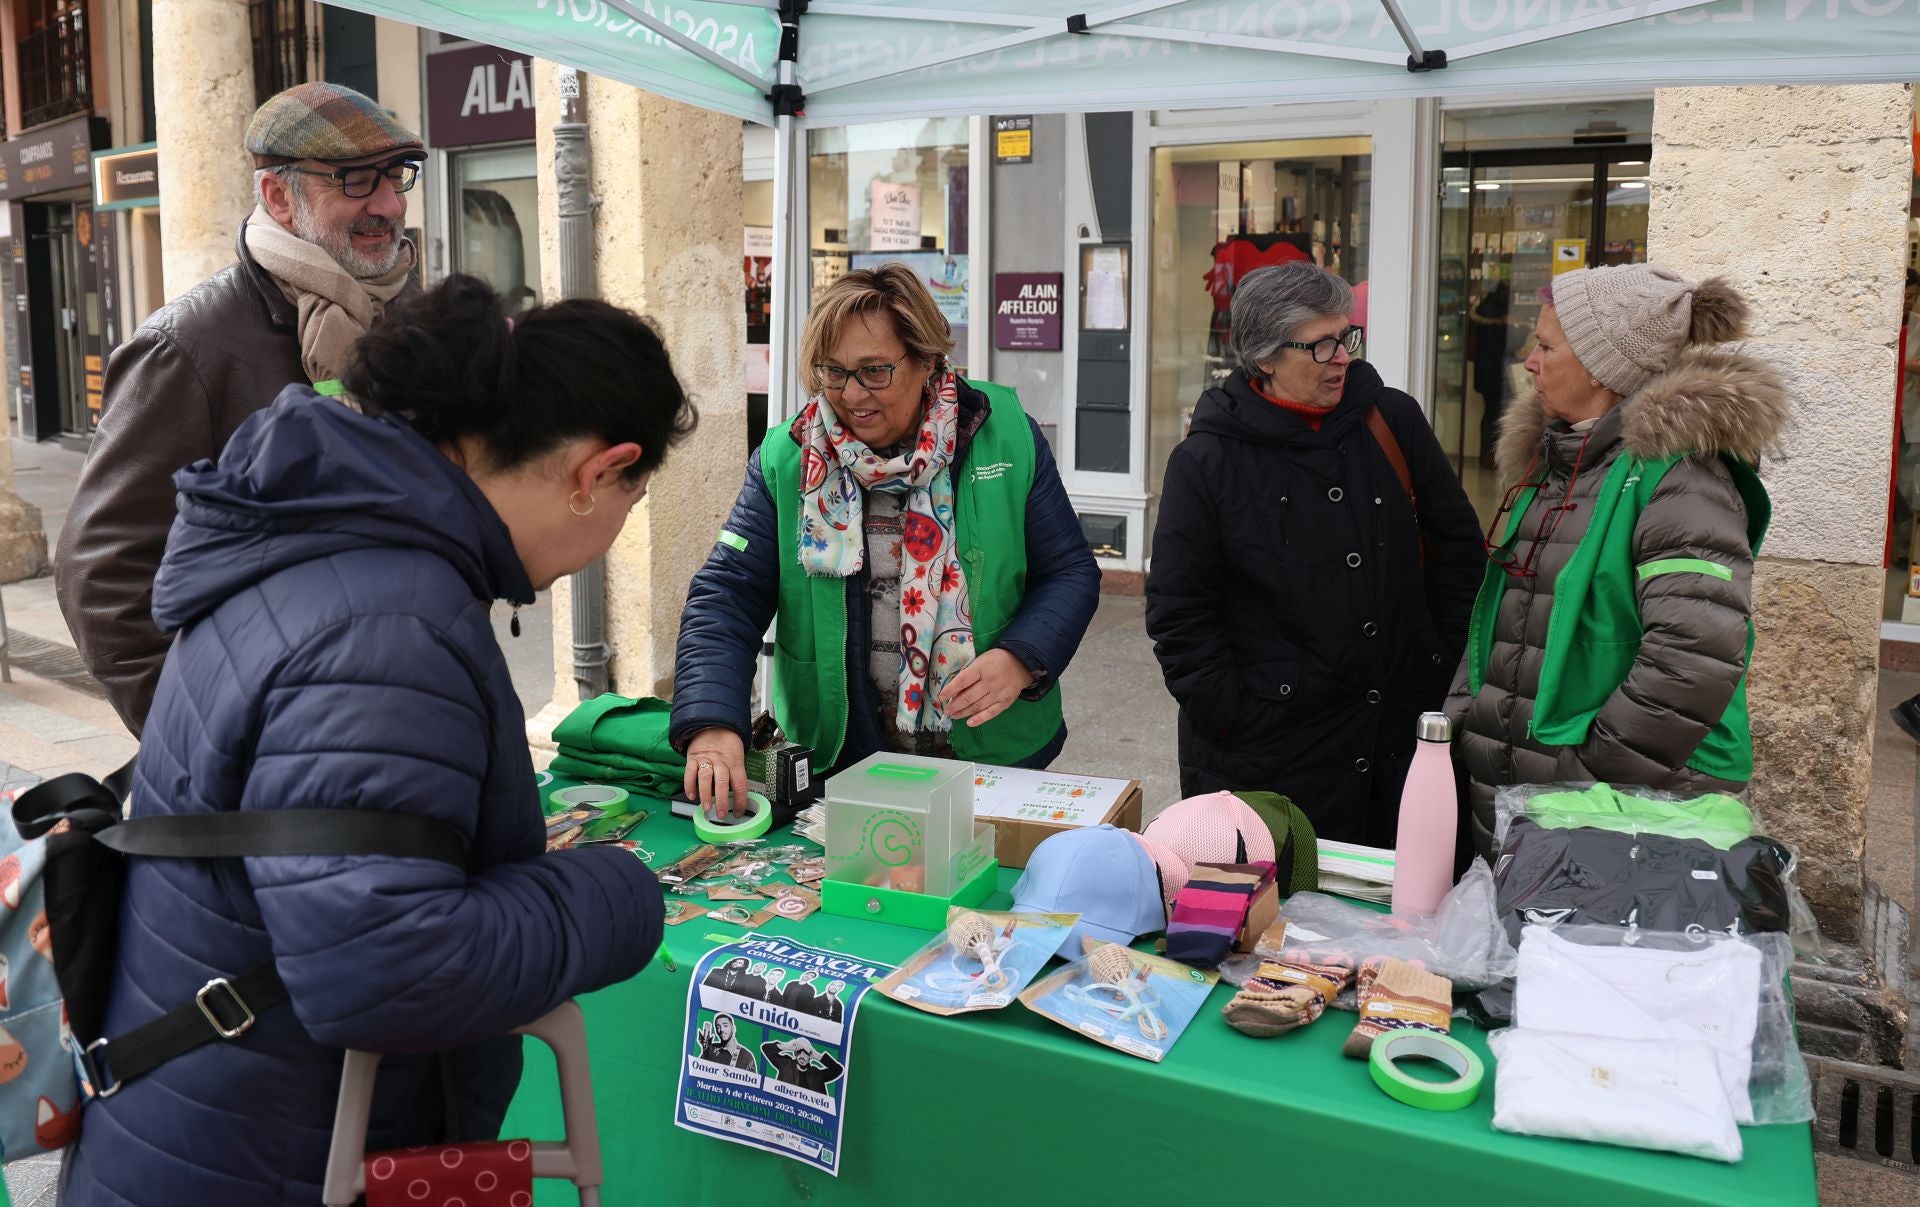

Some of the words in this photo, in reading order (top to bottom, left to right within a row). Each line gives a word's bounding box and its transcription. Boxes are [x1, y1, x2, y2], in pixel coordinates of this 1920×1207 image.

[1019, 284, 1057, 299] ALAIN
[998, 300, 1057, 315] AFFLELOU
[738, 940, 877, 978] PALENCIA
[747, 949, 789, 964] CONTRA
[789, 960, 801, 968] EL
[739, 1001, 755, 1017] el
[759, 1007, 799, 1030] nido
[692, 1060, 719, 1075] Omar
[722, 1069, 758, 1085] Samba
[696, 1080, 723, 1095] Martes
[732, 1089, 743, 1098] de
[744, 1092, 774, 1109] Febrero
[797, 1107, 824, 1125] 20:30h
[774, 1084, 830, 1110] alberto.vela
[686, 1087, 721, 1105] TEATRO
[723, 1095, 771, 1118] PRINCIPAL
[776, 1109, 786, 1121] DE
[790, 1116, 834, 1140] PALENCIA
